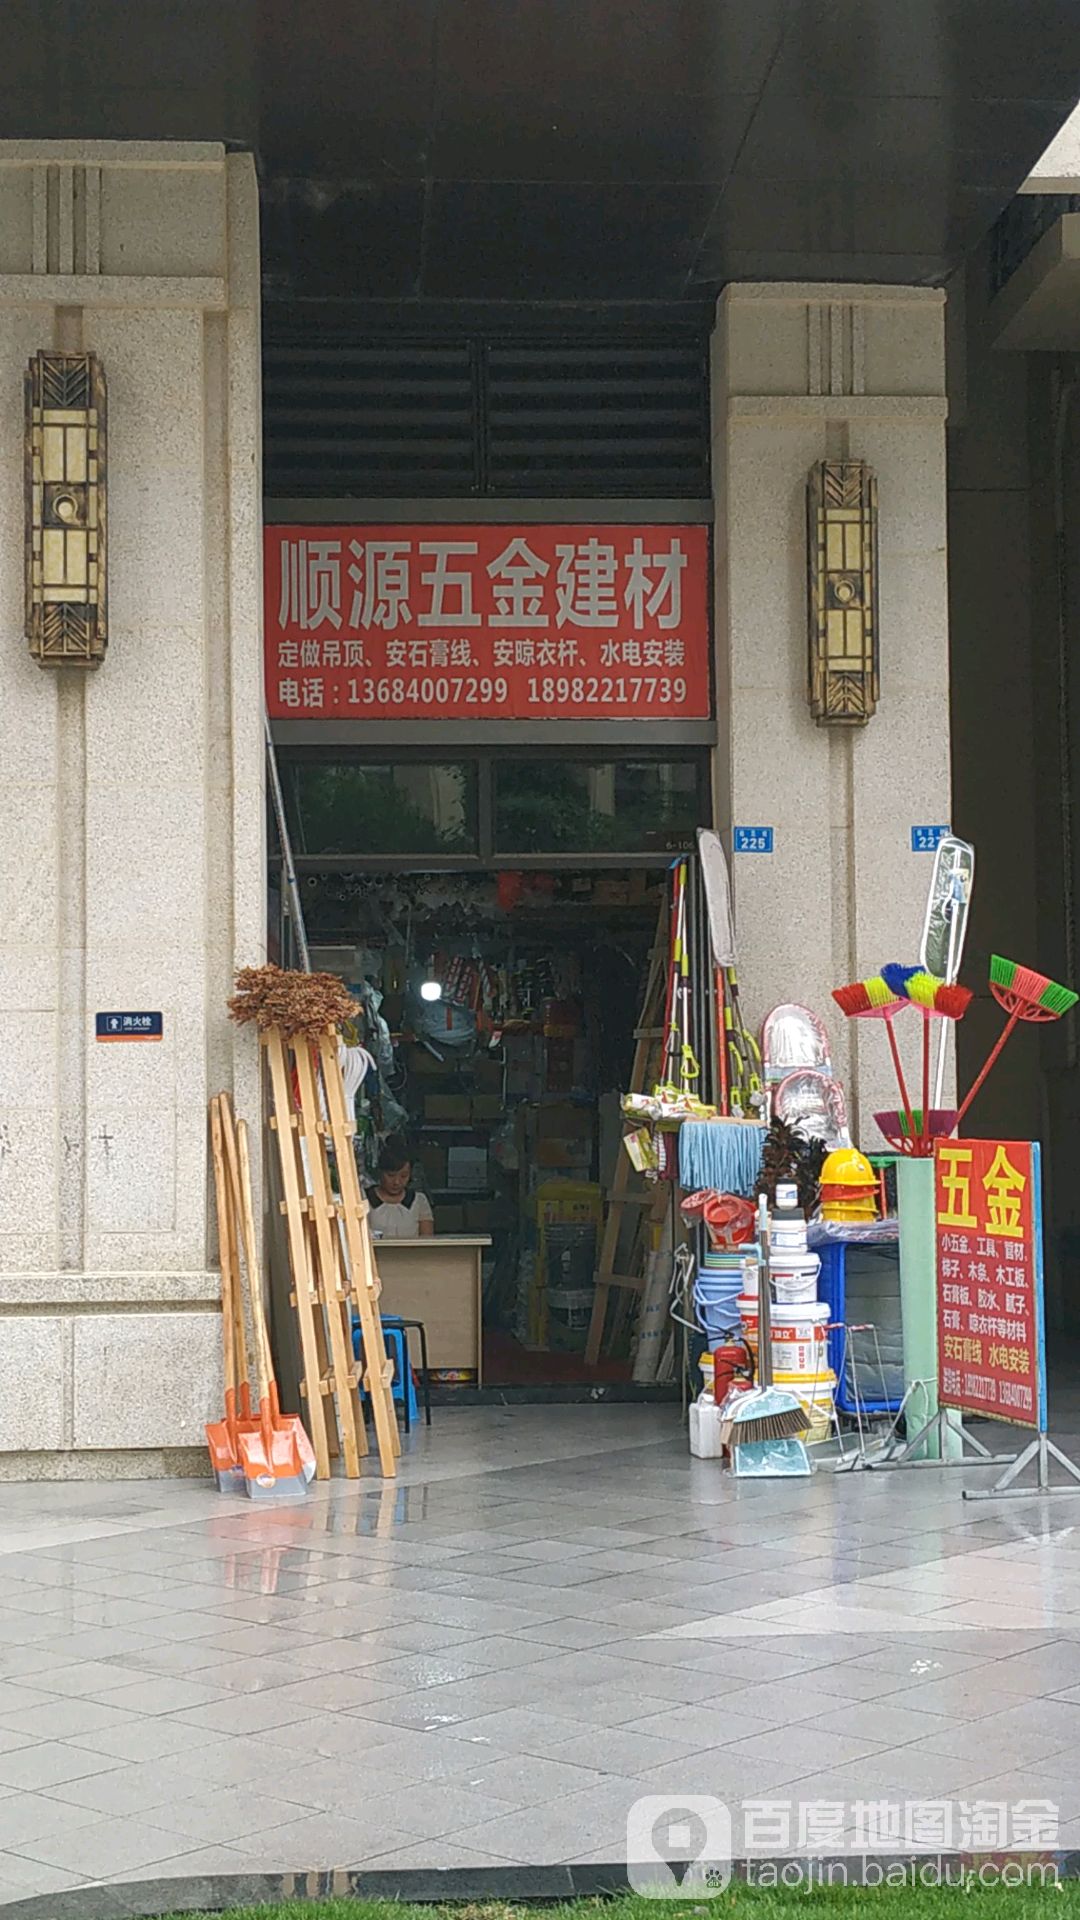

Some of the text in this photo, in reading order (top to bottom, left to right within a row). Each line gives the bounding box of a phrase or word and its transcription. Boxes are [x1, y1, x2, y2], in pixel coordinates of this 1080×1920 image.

[278, 537, 688, 630] 顺源五金建材
[278, 639, 685, 668] 定做吊顶、安石膏线、安晾衣杆、水电安装
[528, 677, 687, 704] 18982217739
[741, 837, 766, 849] 225
[123, 1016, 152, 1026] 消火栓
[937, 1145, 1026, 1238] 五金
